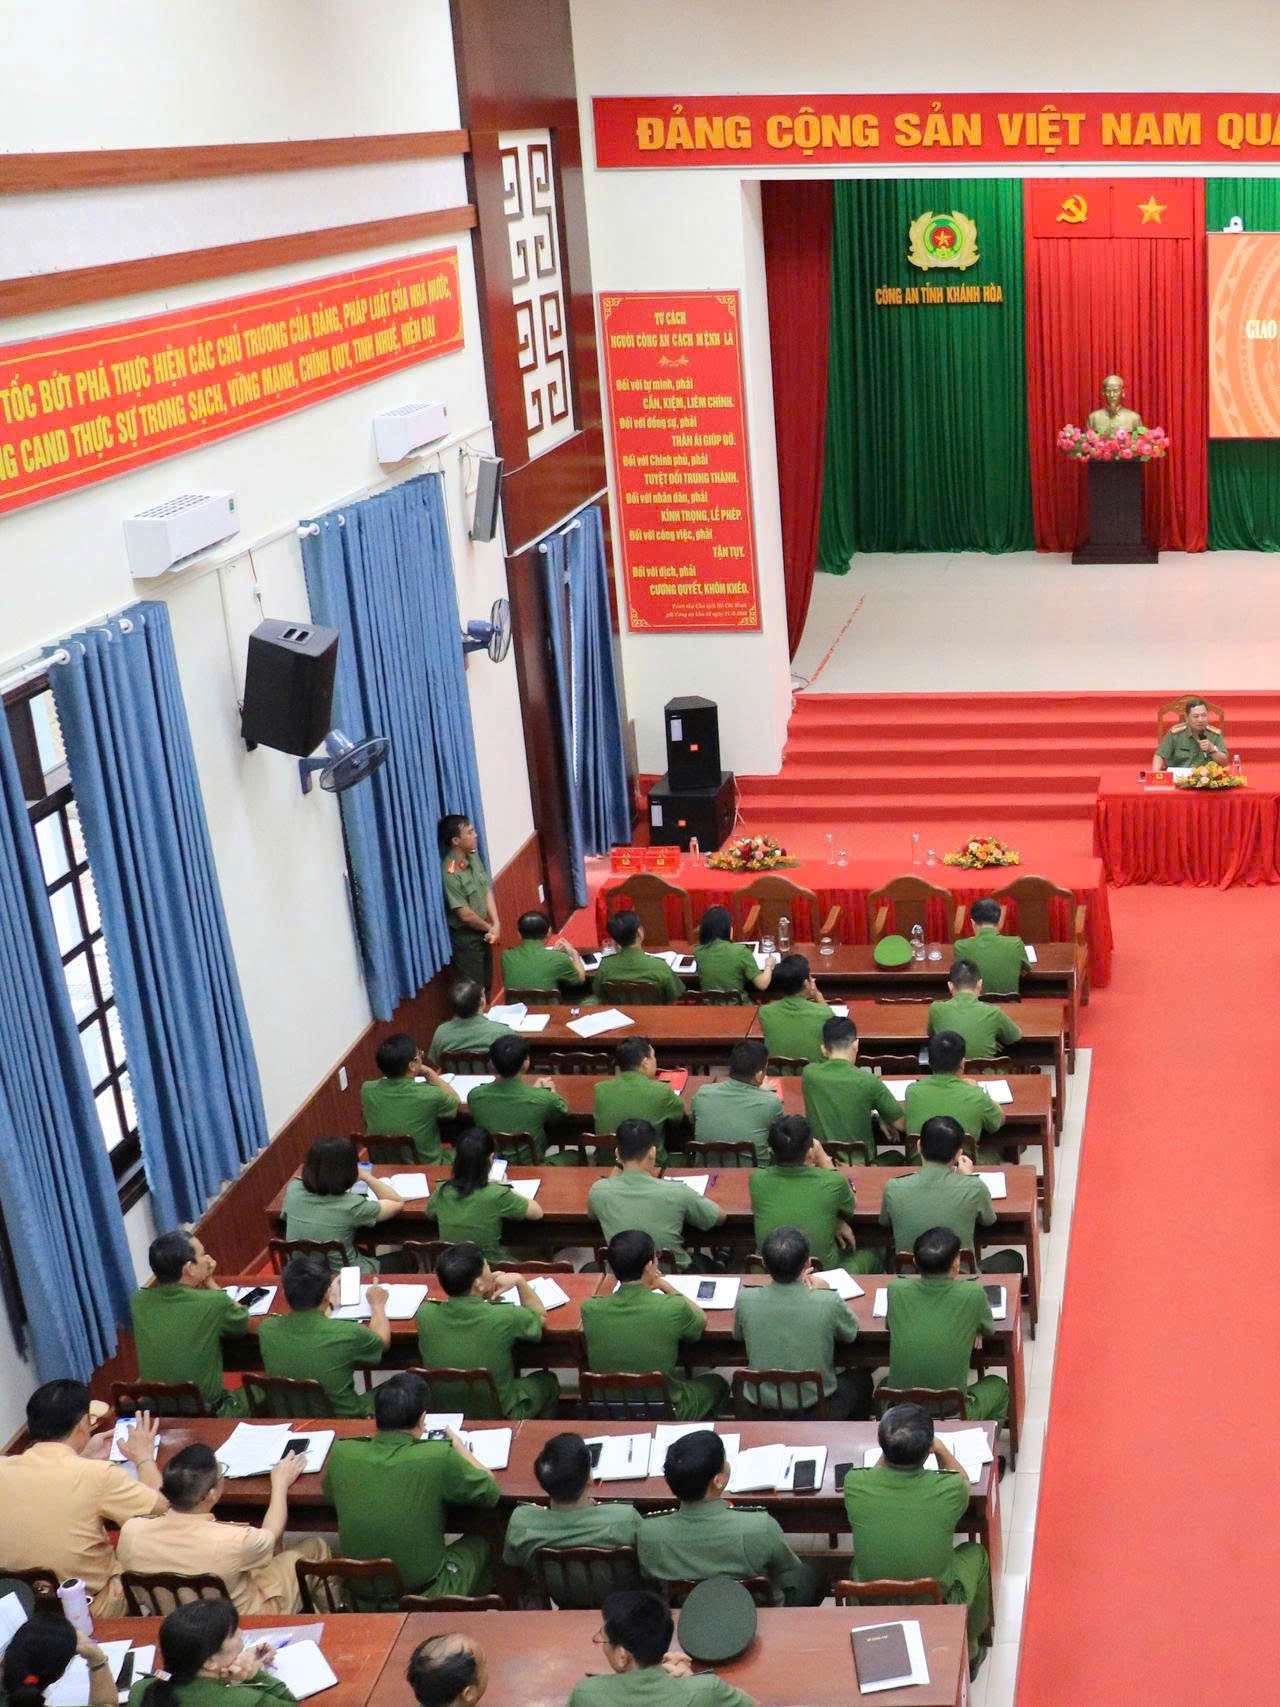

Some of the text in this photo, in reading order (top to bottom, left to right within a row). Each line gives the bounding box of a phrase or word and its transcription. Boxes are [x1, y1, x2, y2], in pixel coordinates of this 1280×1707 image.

[637, 105, 752, 149] ĐẢNG
[766, 108, 879, 156] CỘNG
[895, 102, 981, 146] SẢN
[998, 105, 1085, 153] VIỆT
[1102, 113, 1201, 145] NAM
[905, 288, 918, 304] AN
[0, 374, 37, 423] TỐC
[38, 370, 72, 413] BỨT
[76, 360, 110, 405] PHÁ
[111, 355, 151, 397] THỰC
[153, 344, 187, 387] HIỆN
[189, 337, 215, 374] CÁC
[217, 324, 242, 366] CHỦ
[244, 318, 288, 358] TRƯƠNG
[289, 309, 311, 344] CỦA
[312, 302, 343, 337] ĐẢNG,
[343, 298, 368, 327] PHÁP
[370, 291, 390, 322] LUẬT
[392, 281, 409, 313] CỦA
[20, 429, 69, 472] CAND
[71, 416, 113, 458] THỰC
[116, 405, 137, 447] SỰ
[139, 395, 186, 436] TRONG
[188, 384, 227, 424] SẠCH,
[227, 371, 261, 407] VỮNG
[262, 360, 299, 398] MẠNH,
[299, 346, 330, 382] CHÍNH
